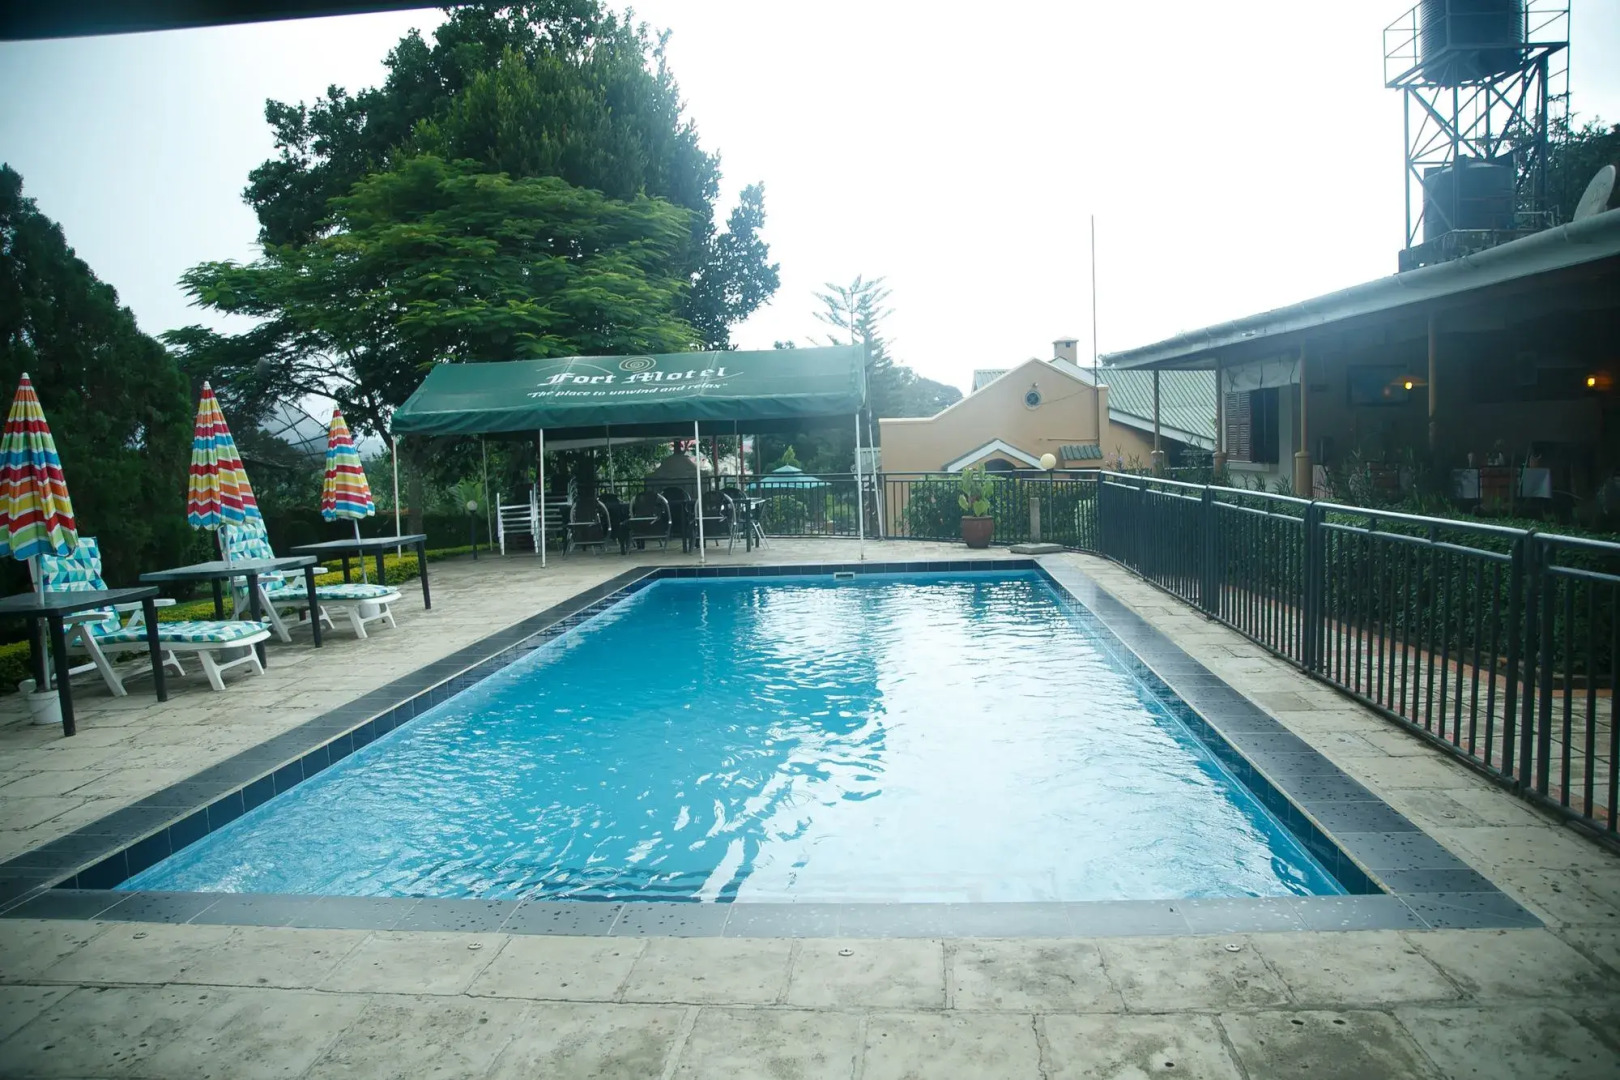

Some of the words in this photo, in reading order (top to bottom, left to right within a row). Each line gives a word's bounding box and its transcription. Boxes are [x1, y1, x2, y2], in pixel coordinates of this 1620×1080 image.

[537, 372, 617, 387] Fort
[621, 367, 726, 384] Motel
[609, 387, 659, 395] unwind
[659, 385, 686, 393] and
